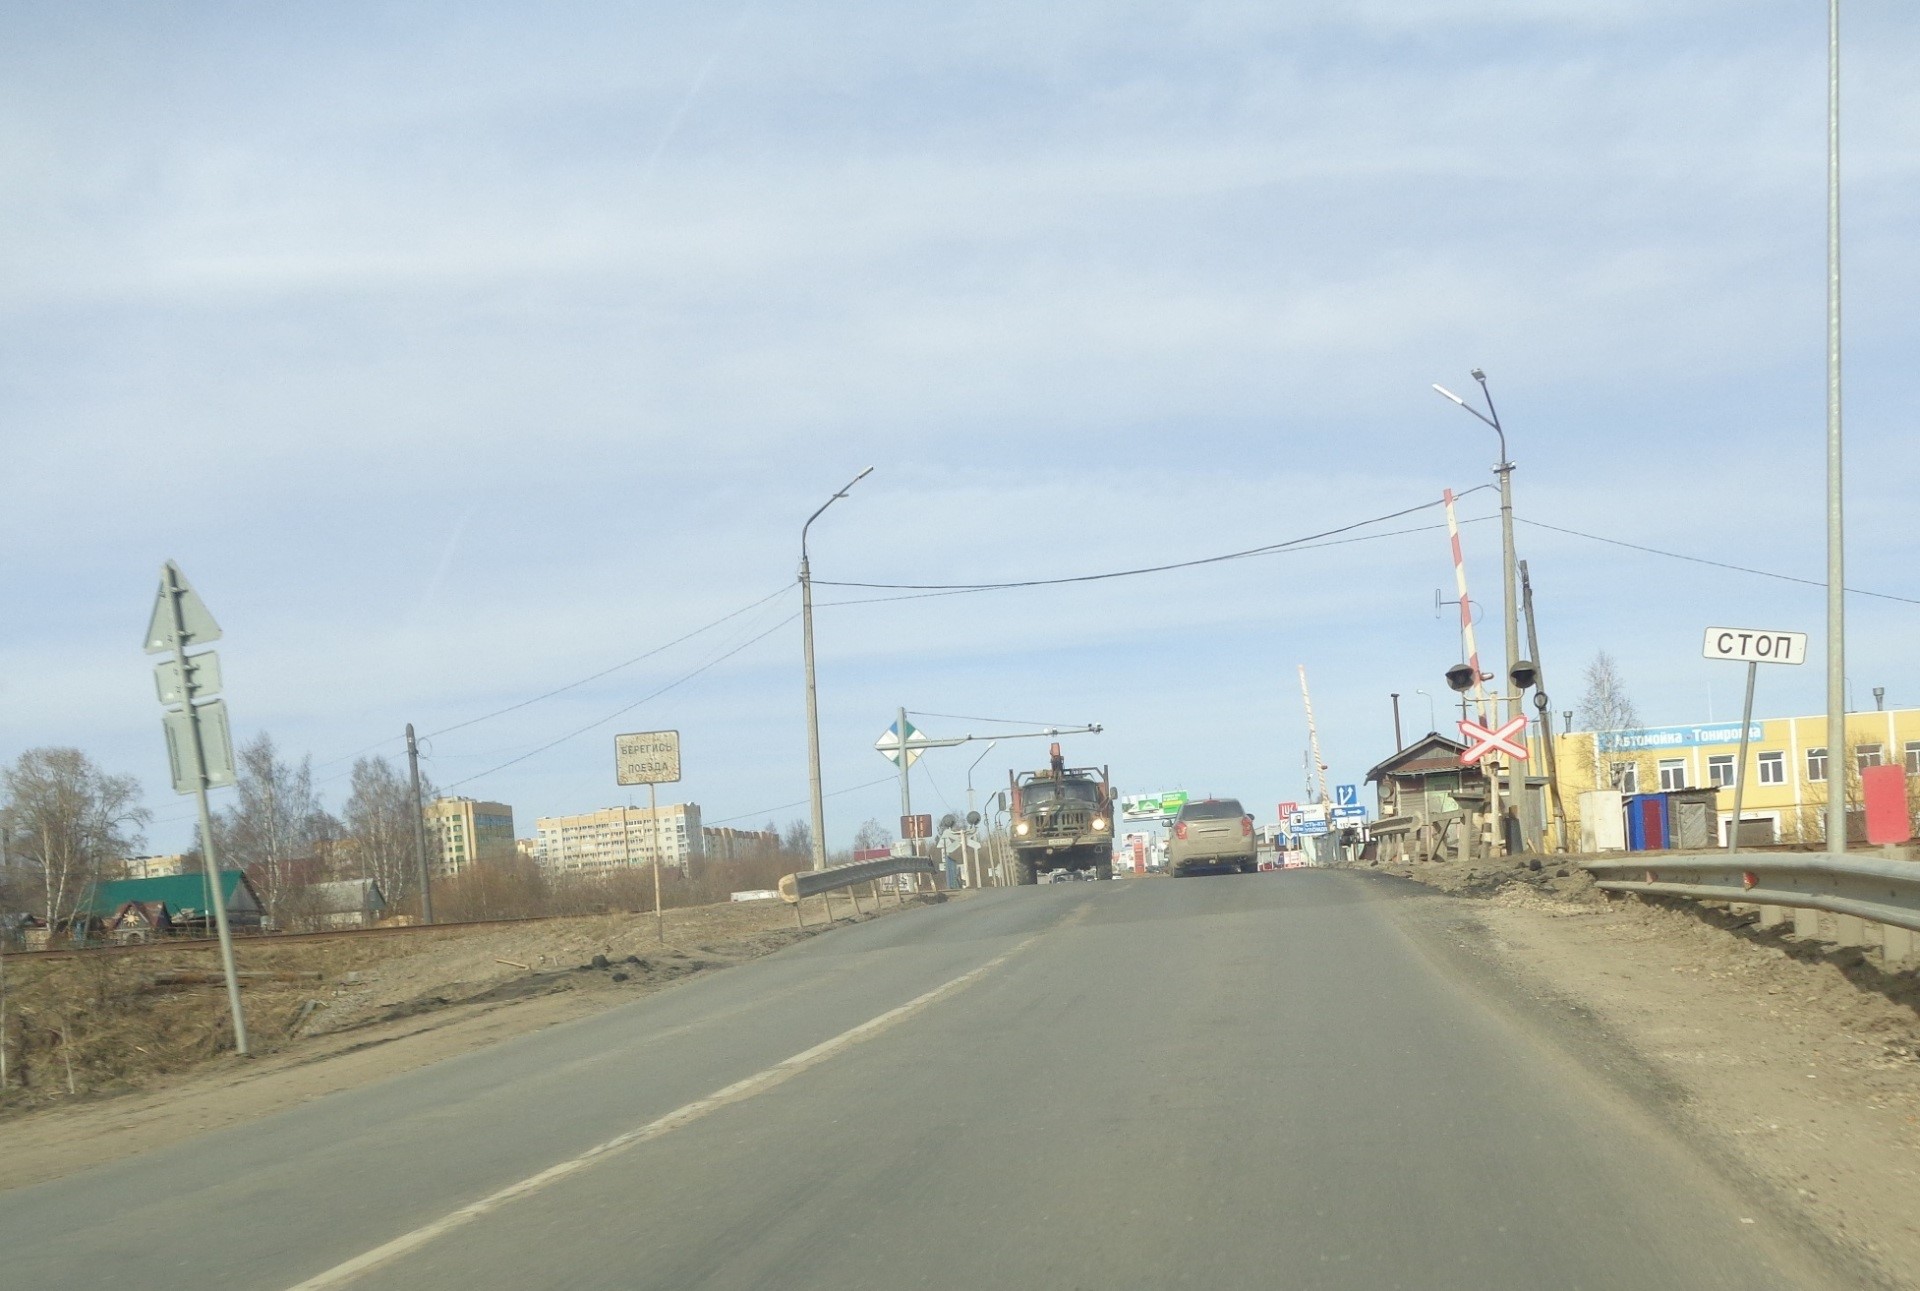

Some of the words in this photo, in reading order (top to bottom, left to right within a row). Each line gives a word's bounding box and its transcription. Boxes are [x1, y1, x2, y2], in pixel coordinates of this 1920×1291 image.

[1717, 632, 1792, 659] СТОП
[1614, 731, 1683, 748] Автомойка
[620, 743, 673, 755] БЕРЕГИСЬ
[628, 762, 669, 774] ПОЕЗДА
